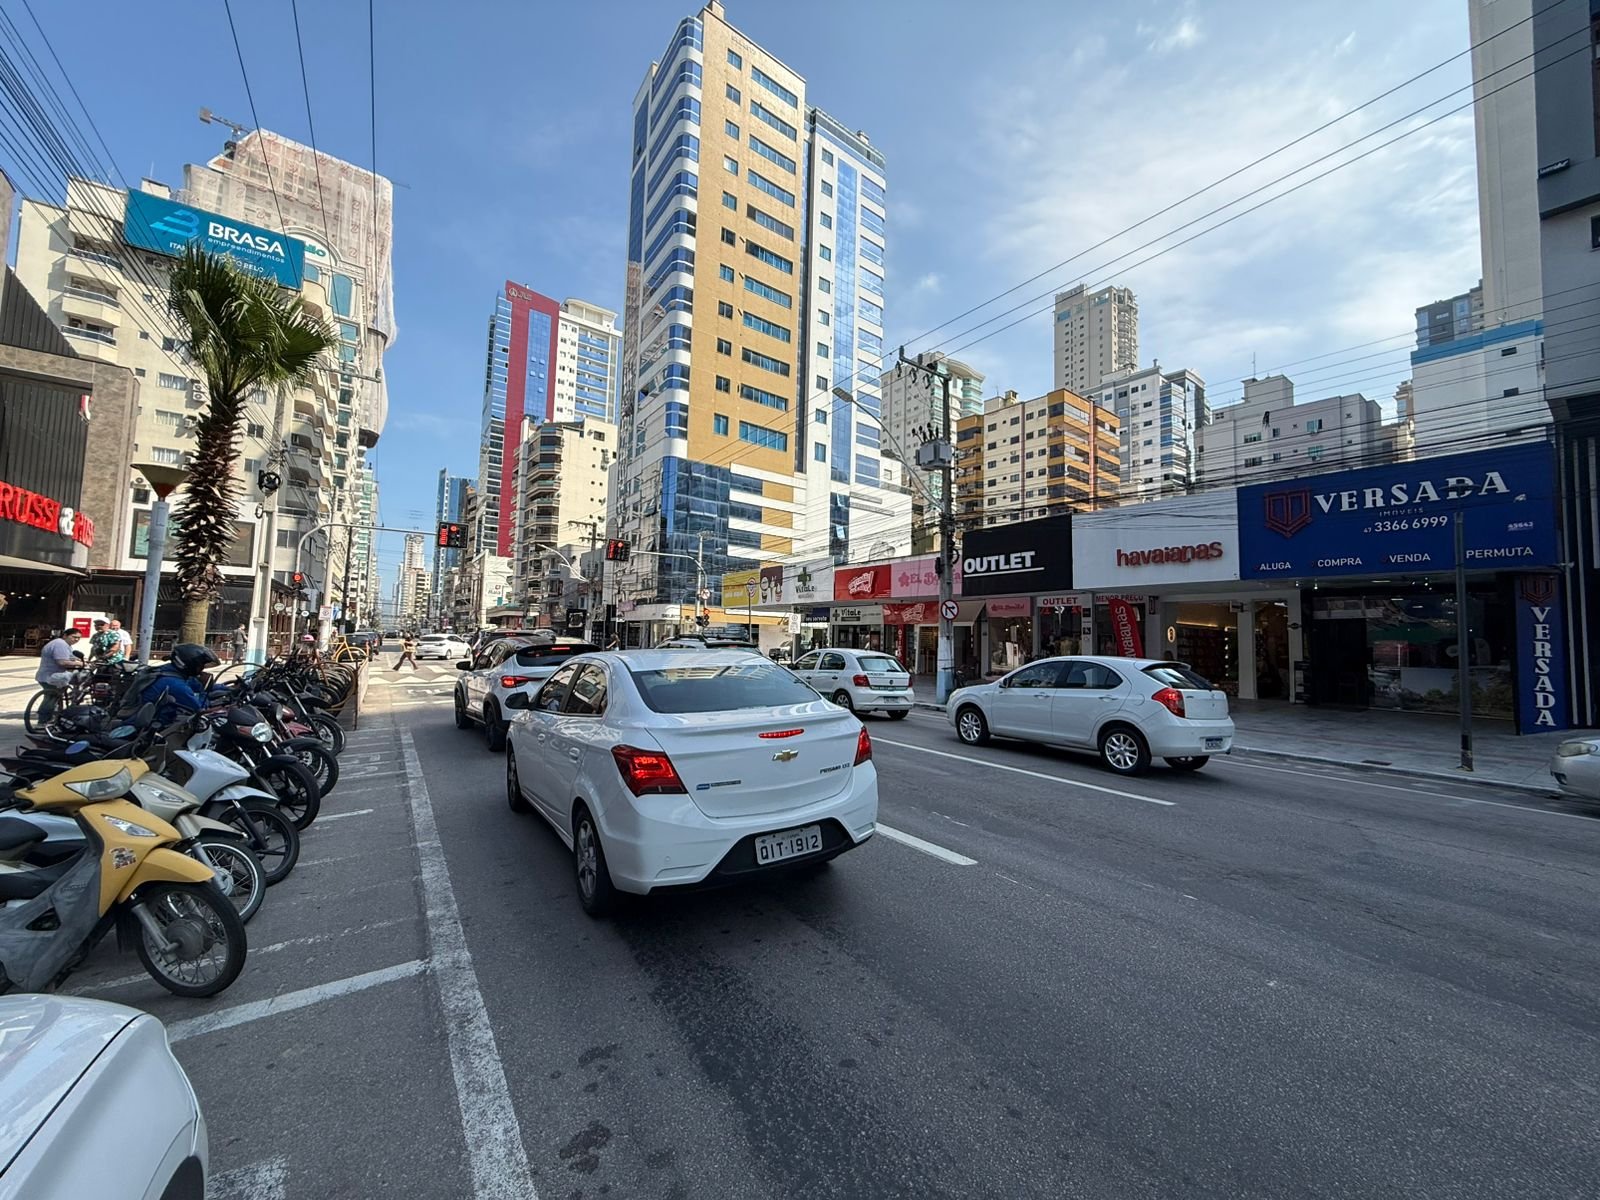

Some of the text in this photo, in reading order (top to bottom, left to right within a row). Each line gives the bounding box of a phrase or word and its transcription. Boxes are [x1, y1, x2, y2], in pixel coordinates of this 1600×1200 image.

[207, 237, 285, 264] empreendimentos
[208, 221, 285, 257] BRASA
[1313, 470, 1510, 513] VERSADA
[0, 480, 61, 534] RUSSI
[59, 507, 75, 536] &
[1374, 520, 1409, 533] 3366
[1411, 515, 1448, 530] 6999
[963, 551, 1036, 574] OUTLET
[1116, 541, 1224, 567] havaianas
[1259, 546, 1534, 571] ALUGA COMPRA VENDA PERMUTA
[1042, 597, 1079, 606] OUTLET
[1530, 606, 1557, 727] VERSADA
